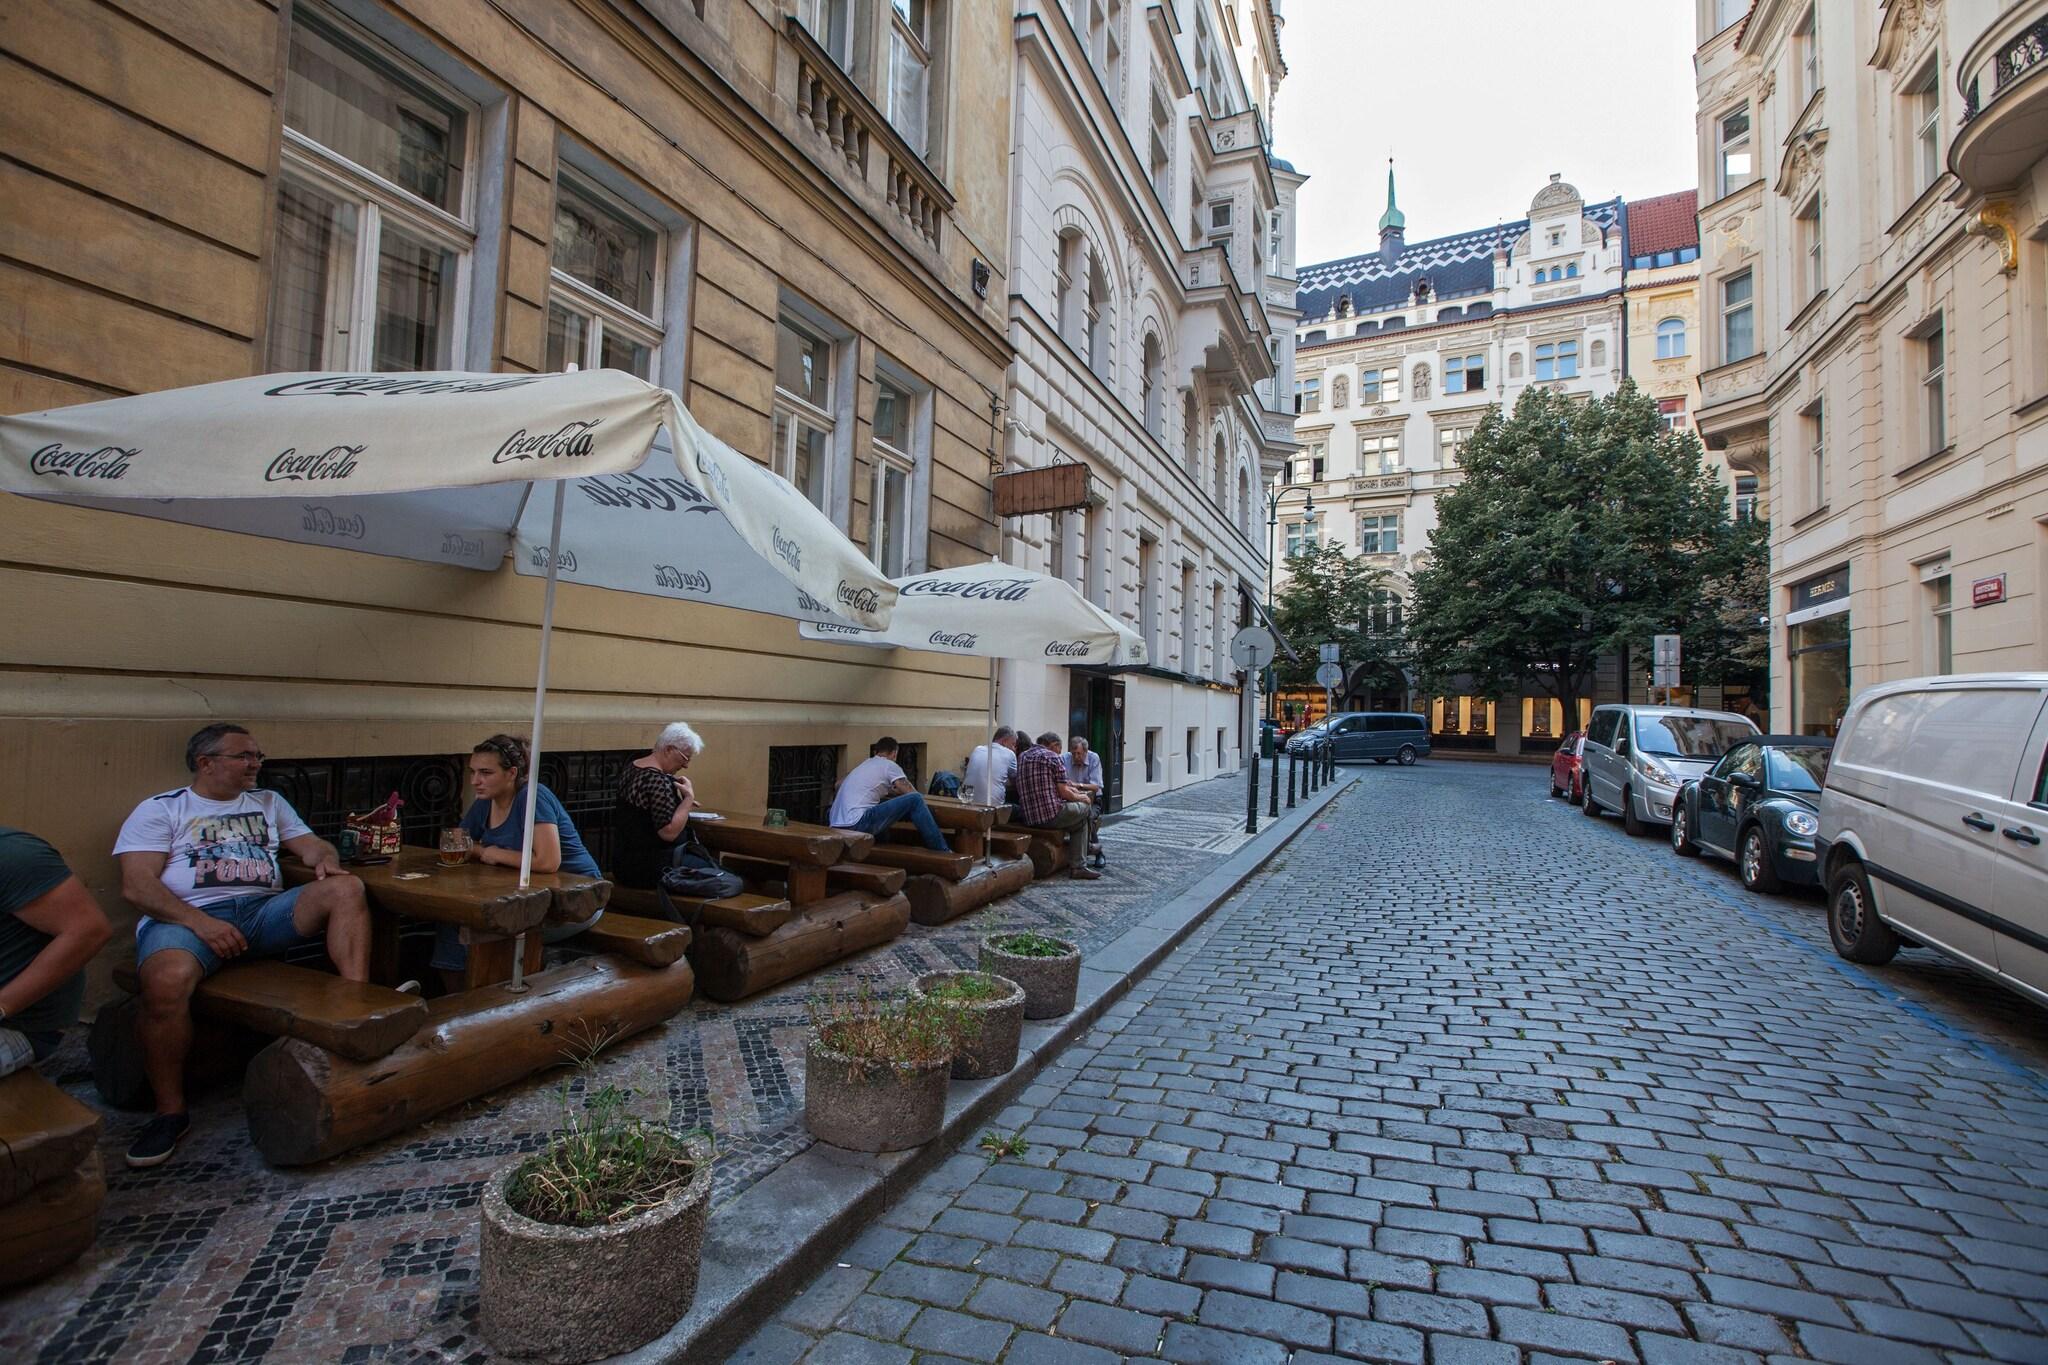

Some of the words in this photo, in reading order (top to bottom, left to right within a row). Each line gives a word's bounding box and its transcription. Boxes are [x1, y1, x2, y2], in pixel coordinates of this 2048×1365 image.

[493, 417, 606, 464] Coca-Cola
[31, 443, 143, 480] Coca-Cola
[264, 444, 369, 482] Coca-Cola
[837, 580, 880, 614] Coca-Cola
[900, 578, 1041, 602] Coca-Cola
[928, 630, 980, 649] Coca-Cola
[1044, 640, 1093, 657] Coca-Cola
[192, 813, 269, 842] INK
